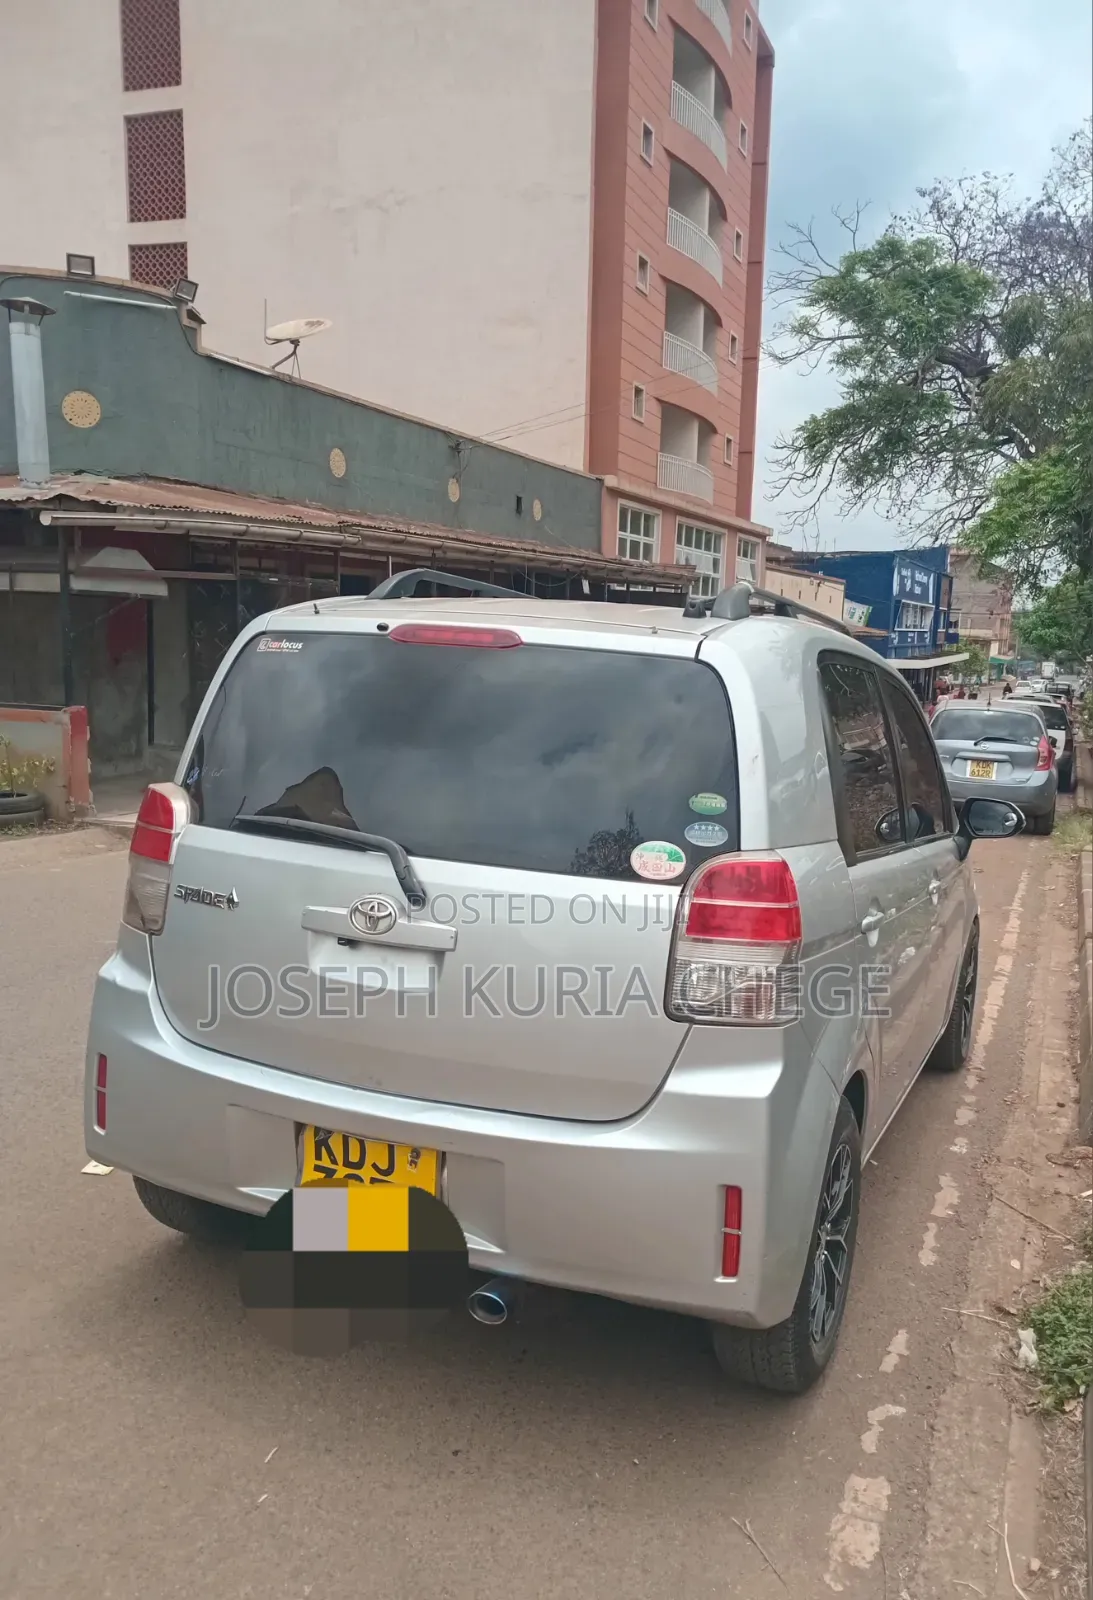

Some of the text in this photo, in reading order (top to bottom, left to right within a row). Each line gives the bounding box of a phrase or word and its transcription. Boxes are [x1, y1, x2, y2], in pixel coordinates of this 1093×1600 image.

[975, 760, 992, 770] KDK
[970, 769, 991, 777] 612R
[314, 1126, 396, 1177] KDJ
